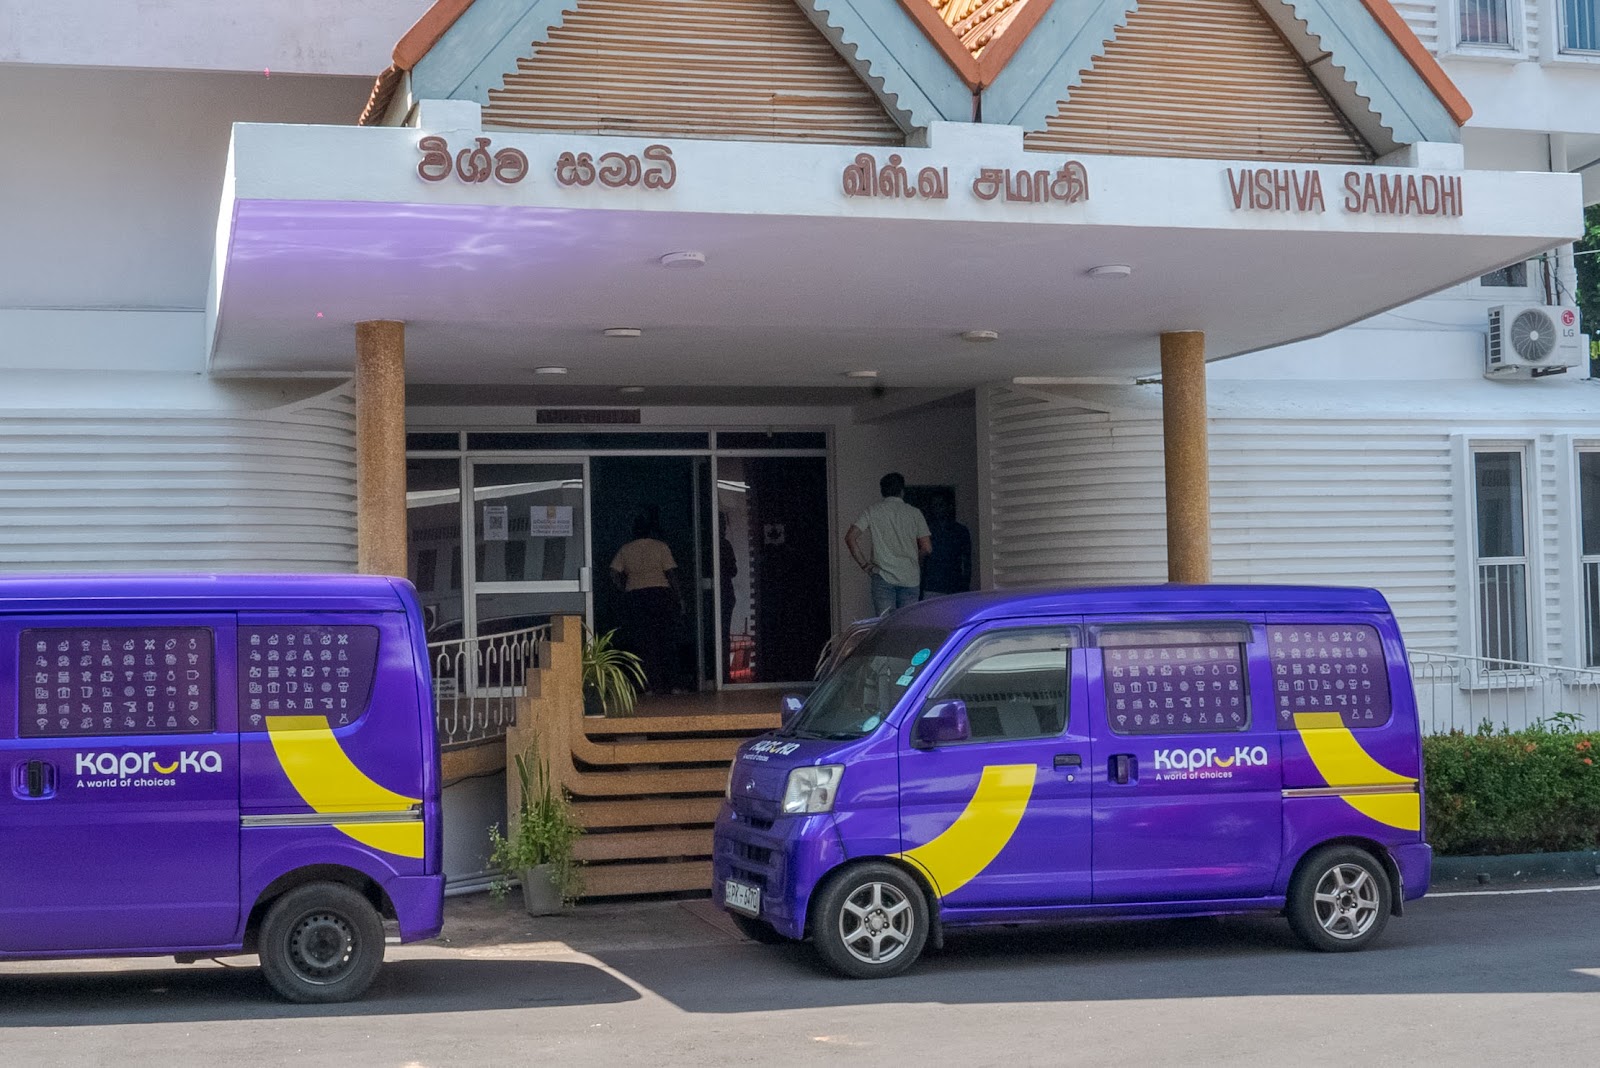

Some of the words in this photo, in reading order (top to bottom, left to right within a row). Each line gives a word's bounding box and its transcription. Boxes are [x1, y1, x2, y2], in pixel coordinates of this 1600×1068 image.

[418, 136, 529, 184] විශ්ව
[556, 144, 677, 190] සමාධි
[1226, 168, 1325, 212] VISHVA
[1344, 171, 1463, 216] SAMADHI
[1563, 329, 1574, 337] LG
[1156, 773, 1162, 781] A
[1164, 772, 1187, 780] world
[1189, 771, 1199, 780] of
[1200, 771, 1233, 779] choices
[77, 780, 85, 788] A
[87, 779, 117, 788] world
[120, 778, 131, 787] of
[134, 778, 176, 787] choices
